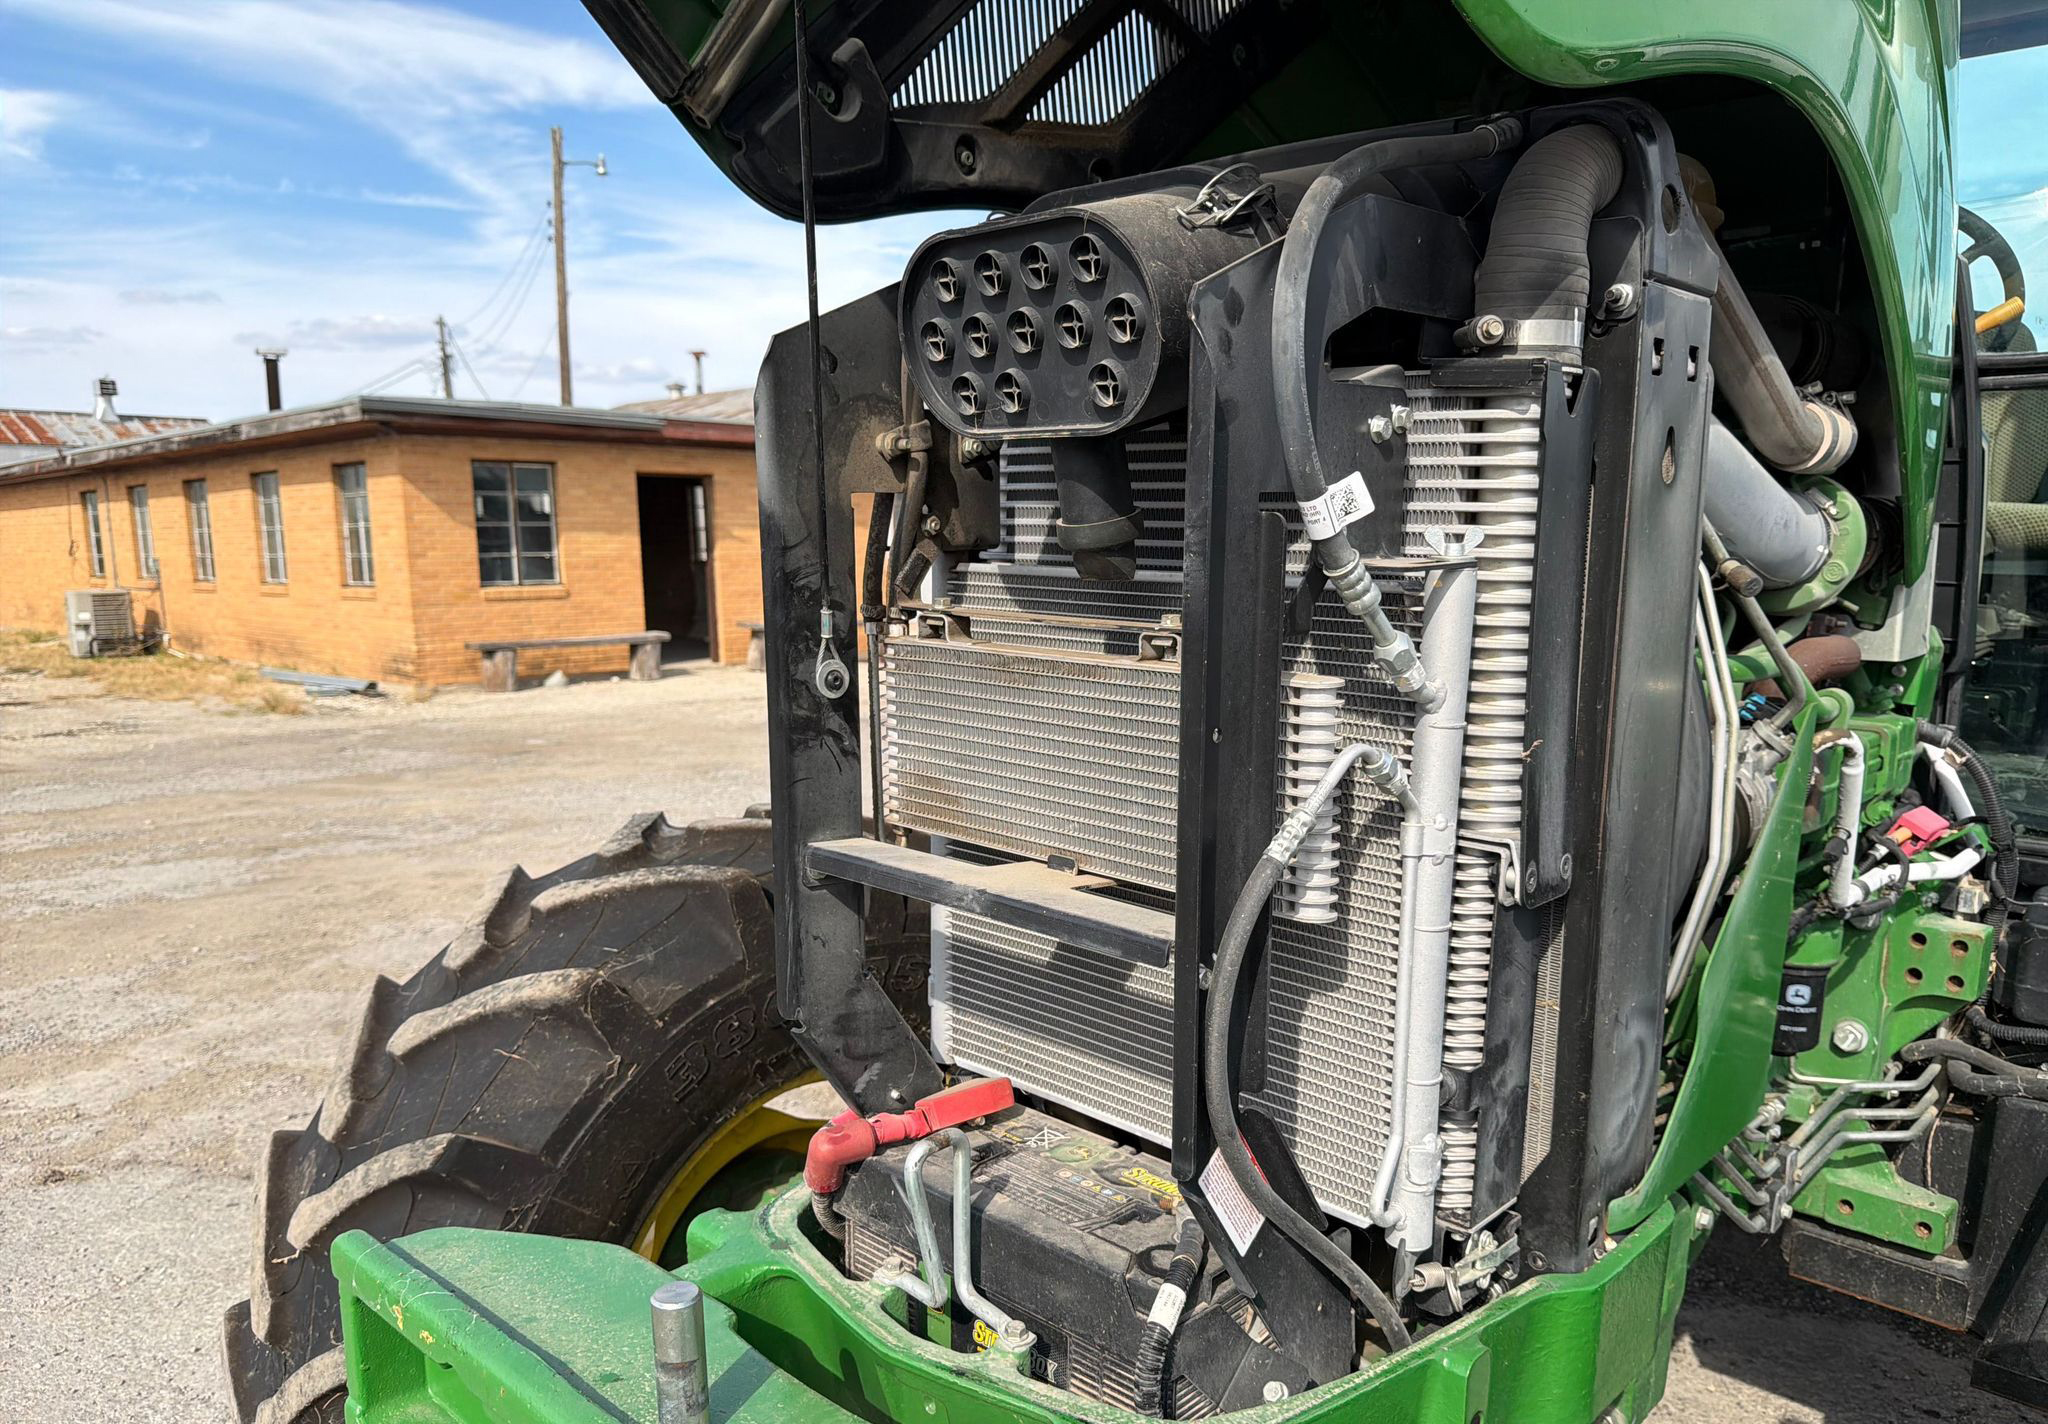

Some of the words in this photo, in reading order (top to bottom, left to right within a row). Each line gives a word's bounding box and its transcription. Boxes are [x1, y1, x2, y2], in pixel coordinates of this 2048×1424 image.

[1306, 505, 1318, 513] LTD
[1775, 1004, 1795, 1013] OHN
[1795, 1006, 1817, 1014] DEERE
